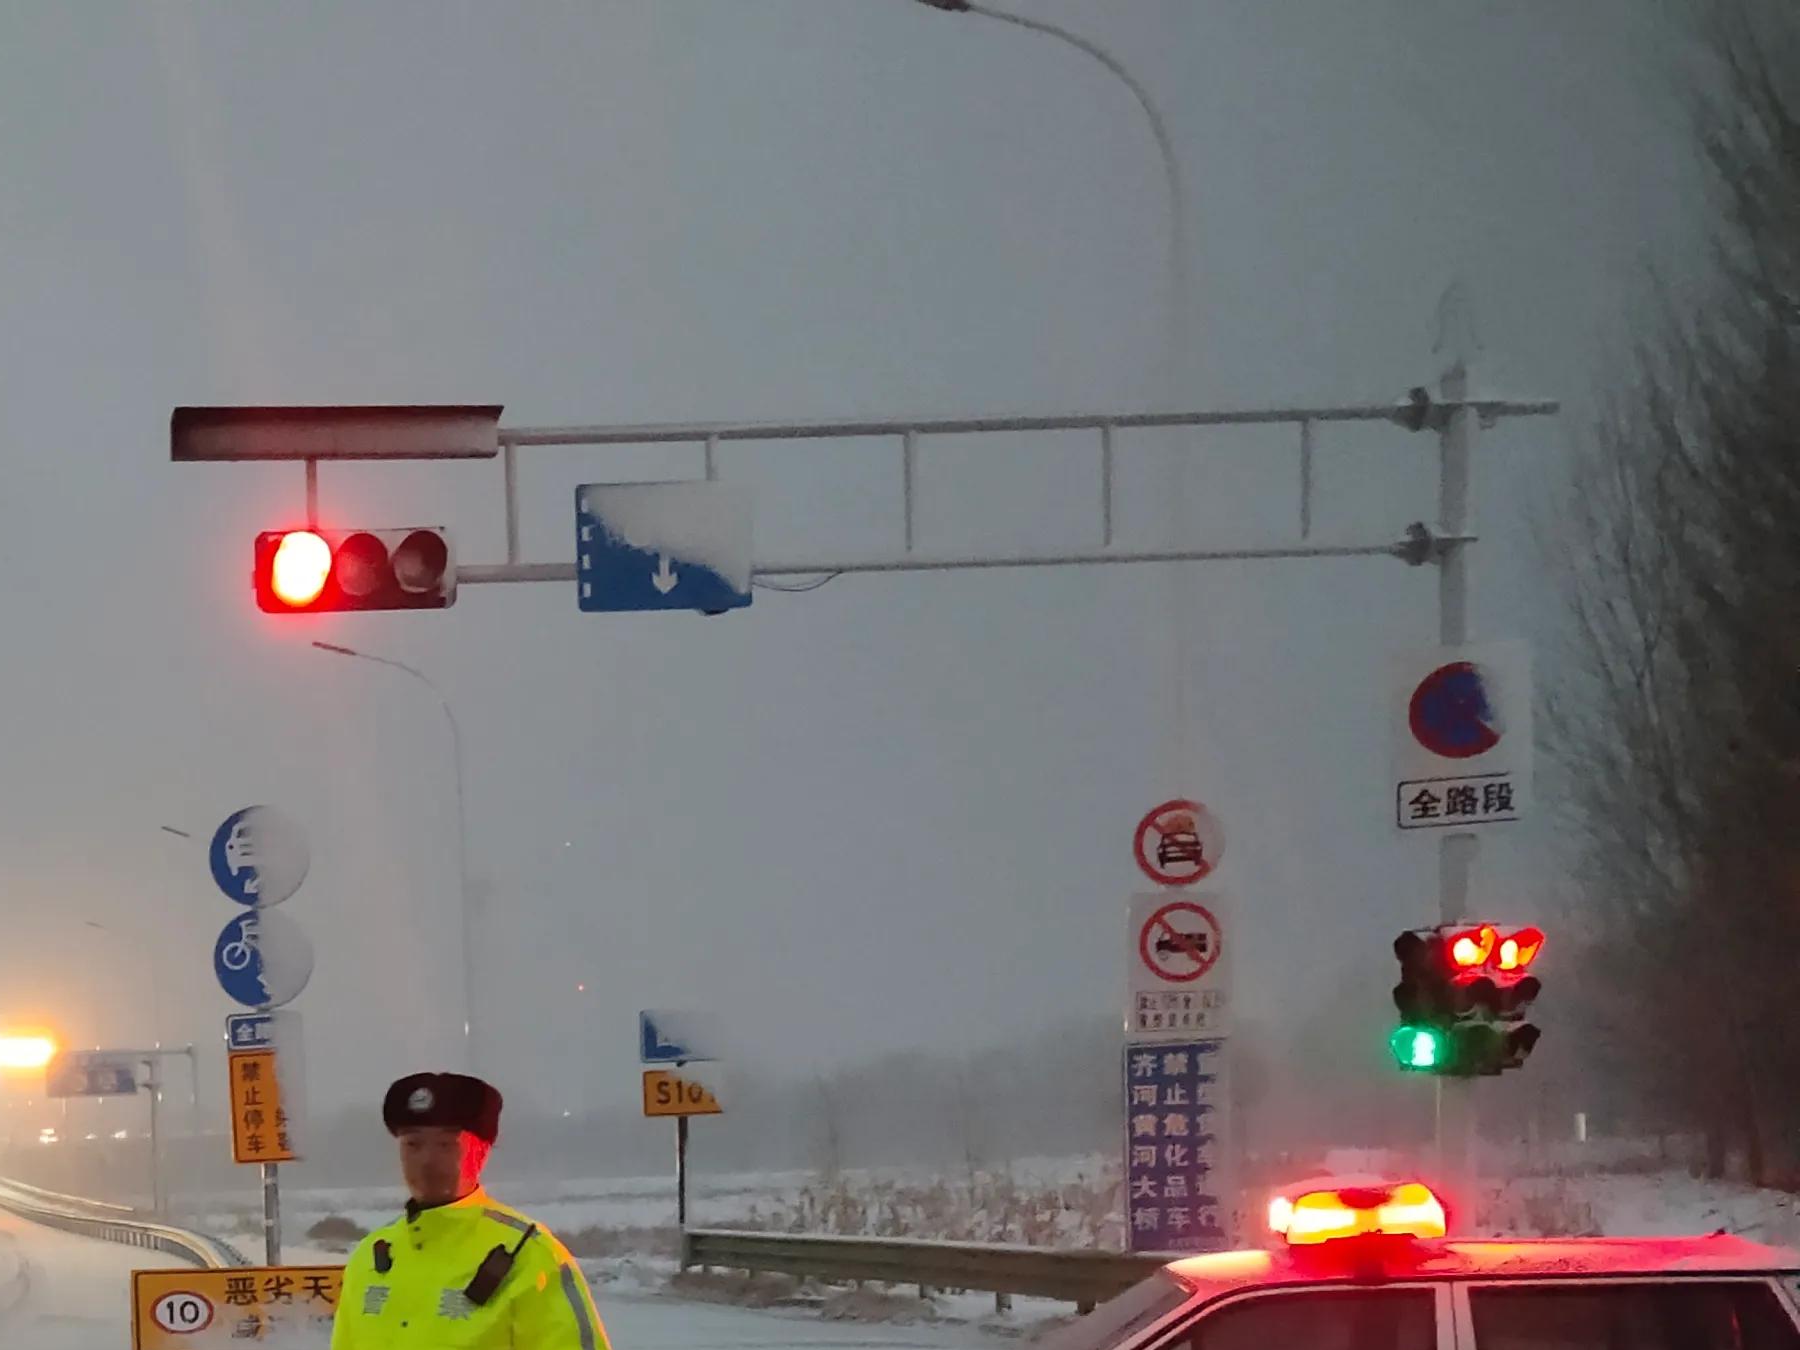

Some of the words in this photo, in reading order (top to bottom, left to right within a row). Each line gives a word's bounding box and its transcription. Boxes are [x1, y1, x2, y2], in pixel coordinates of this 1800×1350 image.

[1408, 782, 1514, 819] 全路段
[241, 1061, 265, 1153] 禁止停车
[1131, 1053, 1160, 1231] 齐河黄河大桥
[225, 1276, 344, 1305] 恶劣天
[166, 1301, 199, 1324] 10
